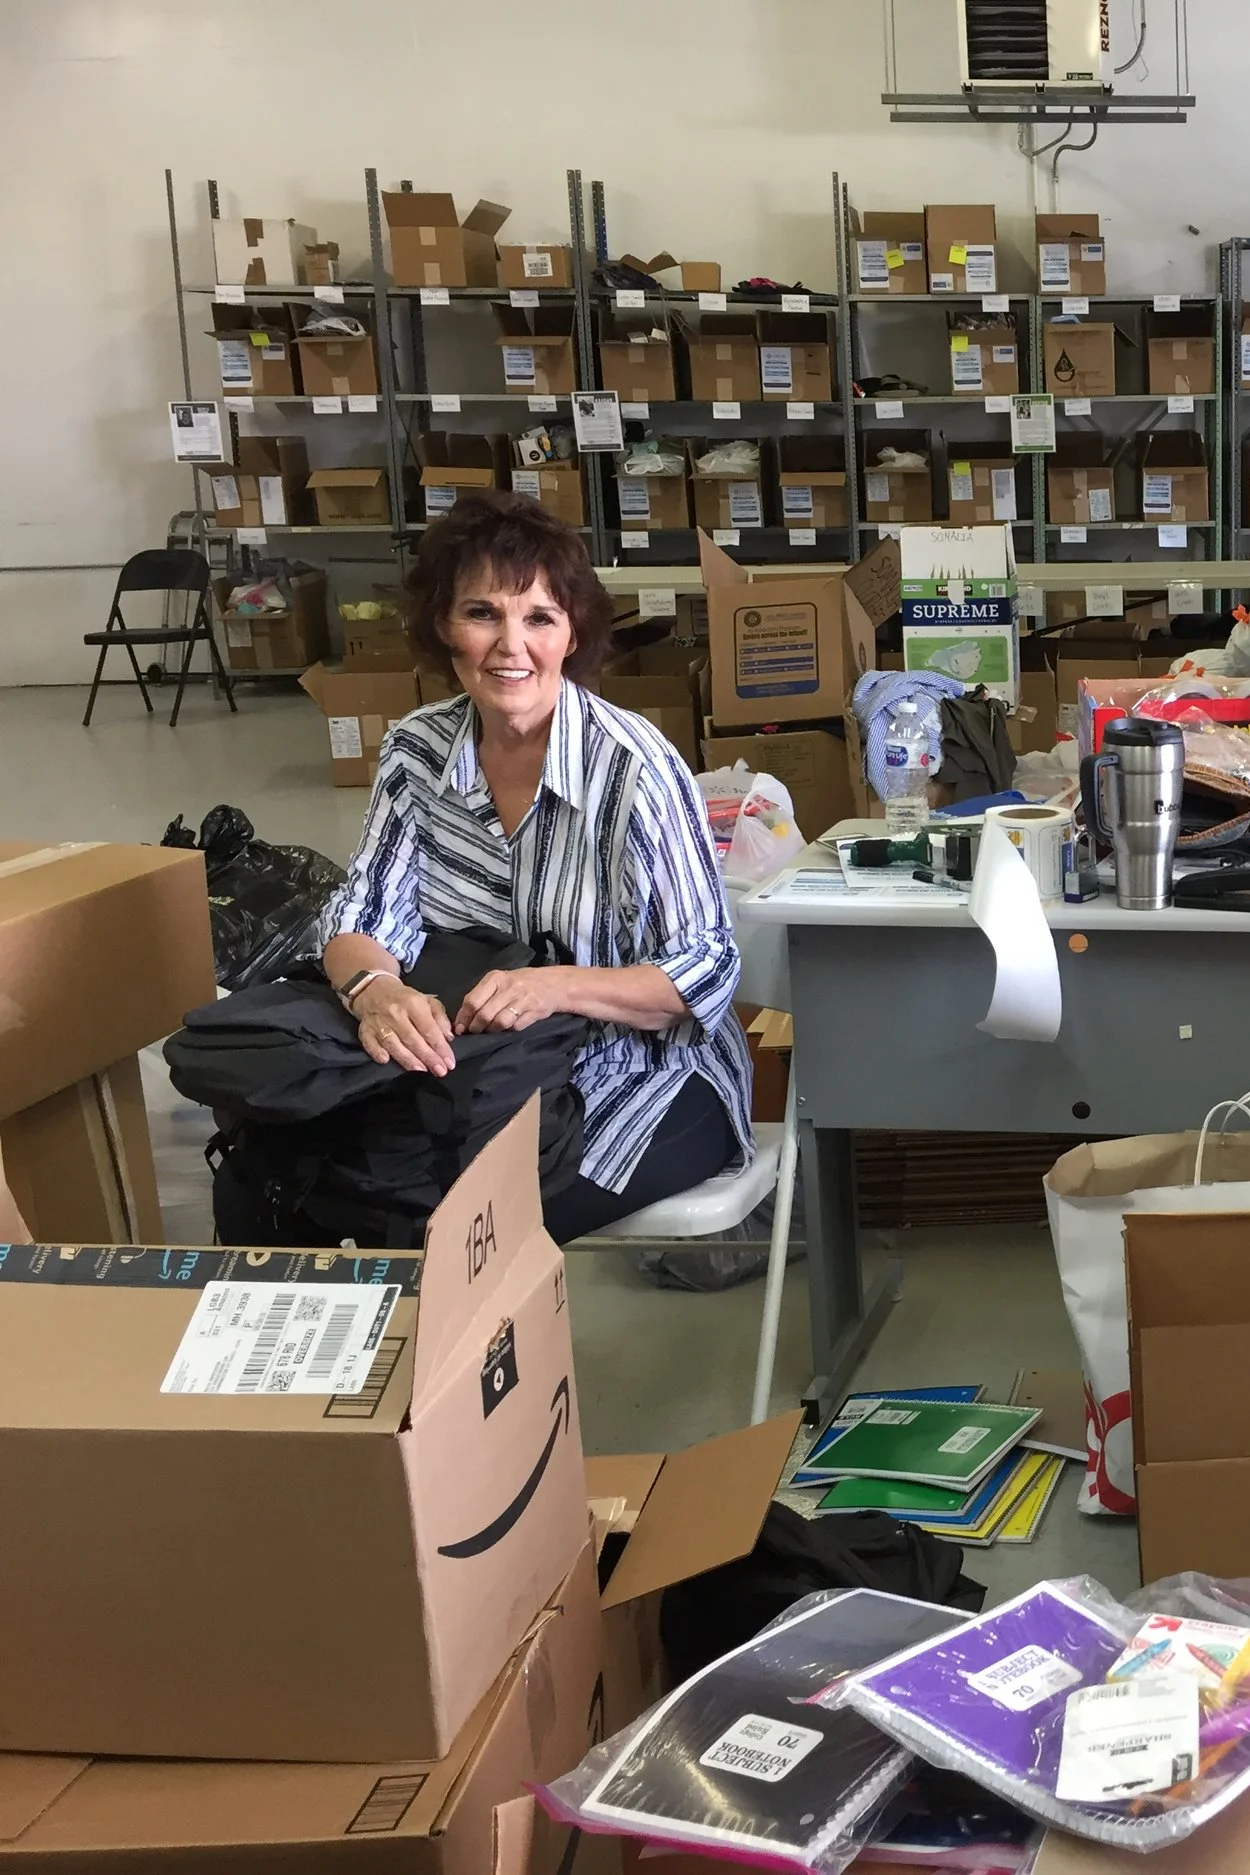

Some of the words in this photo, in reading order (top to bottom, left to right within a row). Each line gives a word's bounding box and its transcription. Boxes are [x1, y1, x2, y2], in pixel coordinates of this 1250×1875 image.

[1100, 0, 1110, 52] REZN
[931, 531, 974, 542] SOMALIA
[912, 604, 999, 618] SUPREME
[465, 1199, 497, 1285] 1BA
[32, 1246, 52, 1275] elivery
[96, 1248, 118, 1280] stening
[288, 1255, 308, 1283] elivery
[293, 1328, 317, 1364] OVERSIZE
[985, 1649, 1041, 1680] SUBJECT
[1012, 1684, 1034, 1698] 70
[744, 1723, 771, 1735] Ruled
[777, 1735, 800, 1750] 70
[708, 1751, 774, 1774] SUBJECT
[718, 1741, 792, 1768] NOTEBOOK
[773, 1767, 784, 1777] 1
